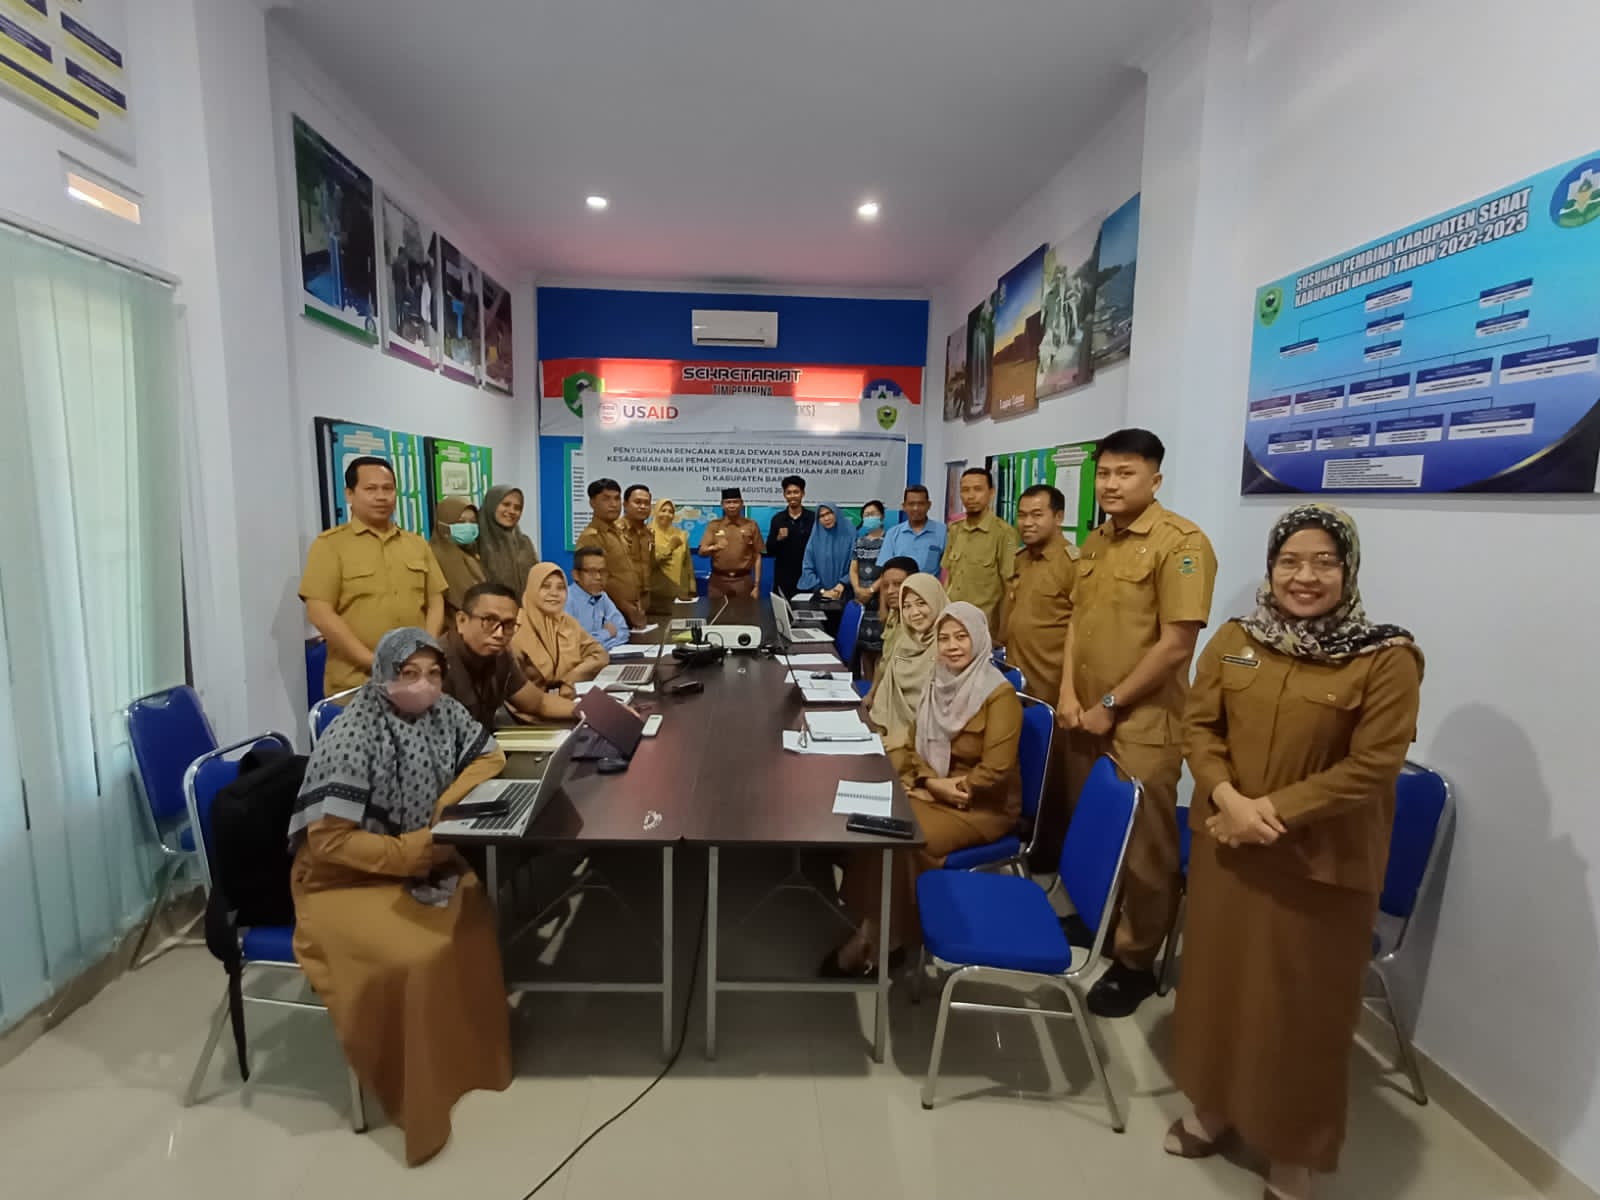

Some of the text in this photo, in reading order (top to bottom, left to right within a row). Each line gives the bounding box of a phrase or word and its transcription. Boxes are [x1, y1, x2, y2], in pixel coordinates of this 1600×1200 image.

[1296, 185, 1533, 292] SUSUNAN PEMBINA KABUPATEN SEHAT
[1294, 273, 1350, 309] KABUPATEN
[1351, 260, 1392, 289] BARRU
[1393, 241, 1437, 274] TAHUN
[1437, 209, 1529, 260] 2022-2023
[682, 367, 802, 382] SEKRETARIAT
[623, 405, 679, 419] USAID
[613, 446, 673, 454] PENYUSUNAN
[674, 447, 716, 455] RENCANA
[719, 448, 746, 456] KERJA
[782, 449, 800, 457] SDA
[821, 450, 881, 458] PENINGKATAN
[663, 456, 684, 464] BAGI
[685, 456, 734, 465] PEMANGKU
[799, 458, 843, 466] MENGENAI
[631, 464, 684, 473] PERUBAHAN
[686, 465, 709, 473] IKLIM
[758, 466, 823, 475] KETERSEDIAAN
[824, 467, 839, 475] AIR
[841, 468, 865, 476] BAKU
[702, 474, 711, 482] DI
[713, 475, 763, 483] KABUPATEN
[742, 486, 773, 494] AGUSTUS
